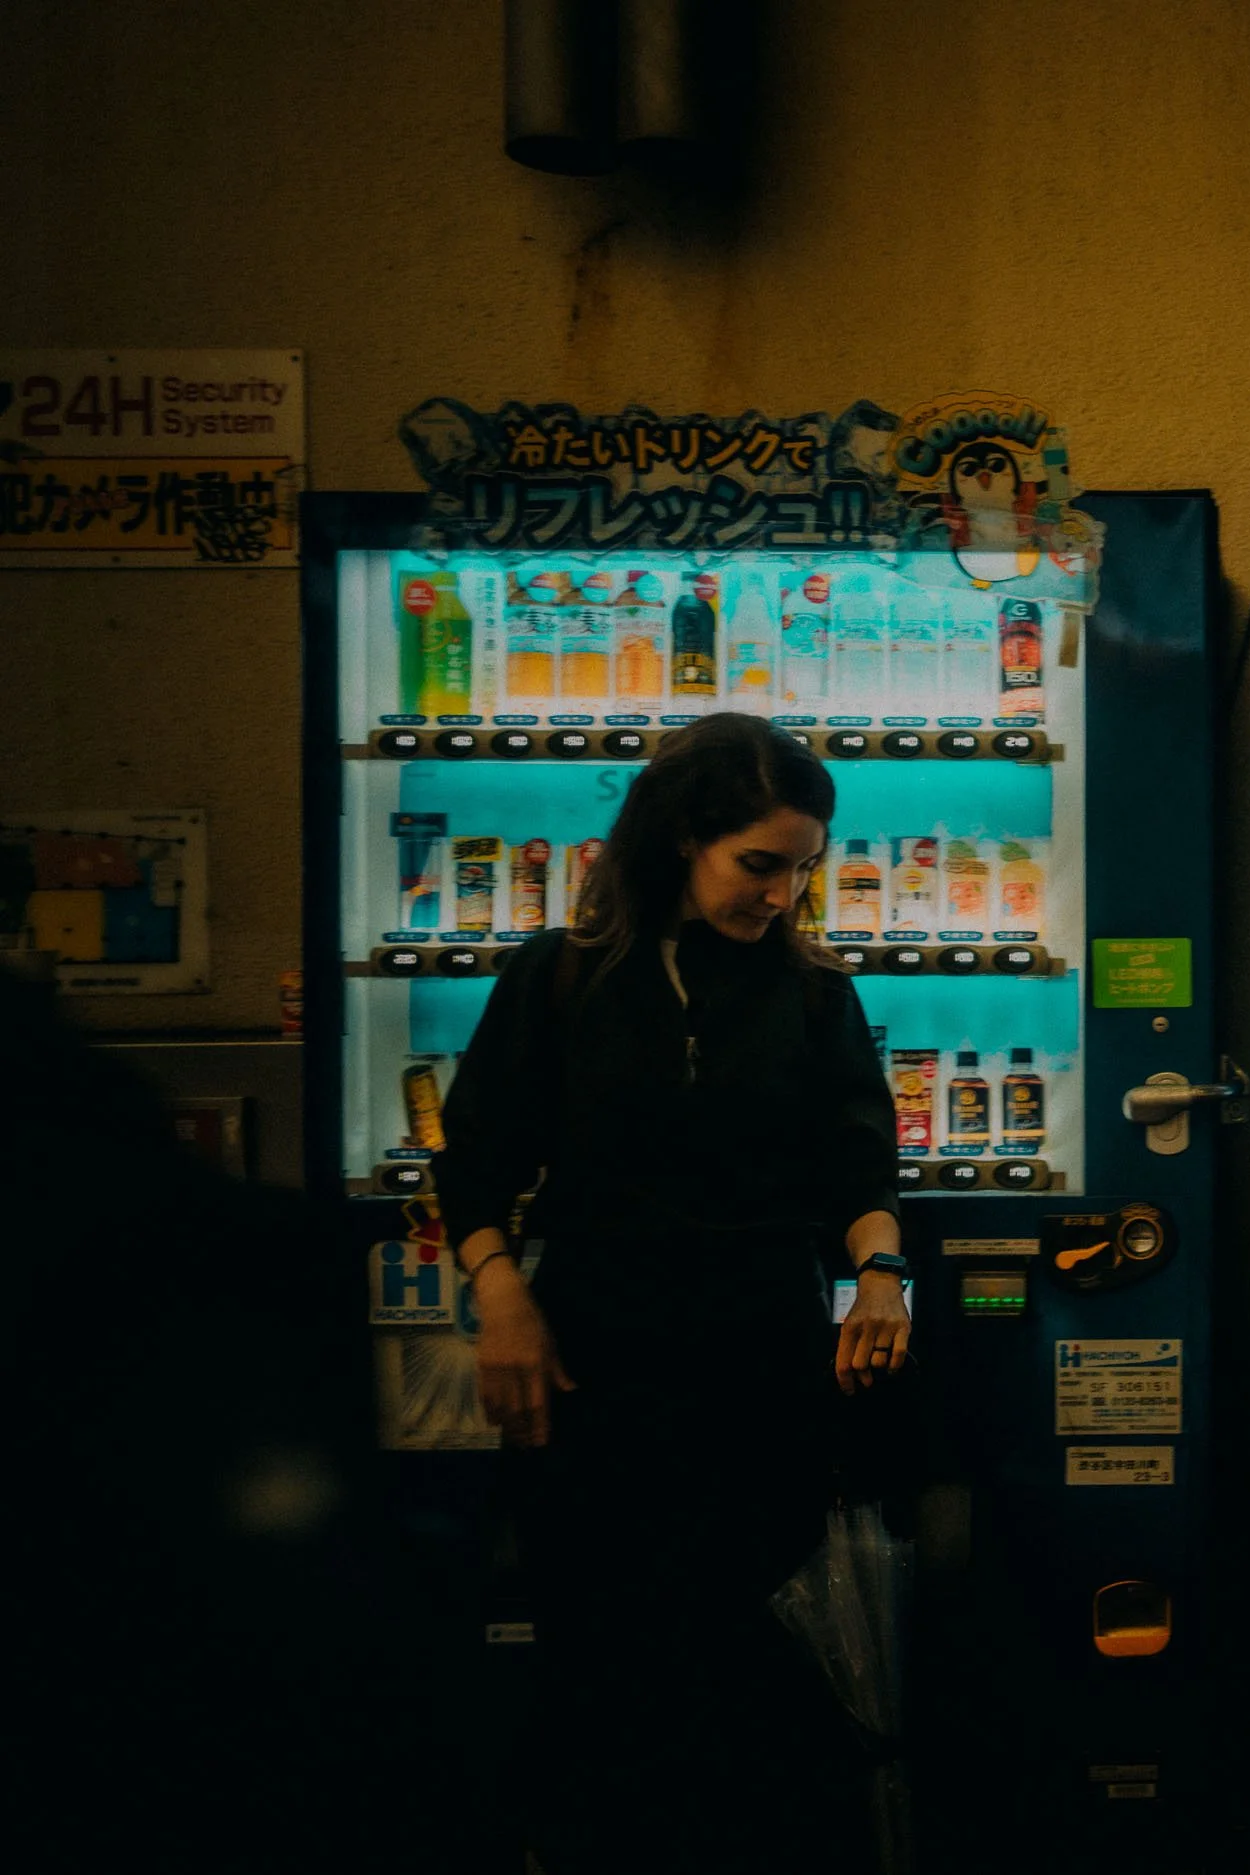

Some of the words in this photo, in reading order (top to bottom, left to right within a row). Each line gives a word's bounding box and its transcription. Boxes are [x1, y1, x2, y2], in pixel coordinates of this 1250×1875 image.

[22, 376, 153, 436] 24H
[162, 376, 286, 406] Security
[163, 409, 276, 437] System
[506, 422, 815, 472] 冷たいドリンクで
